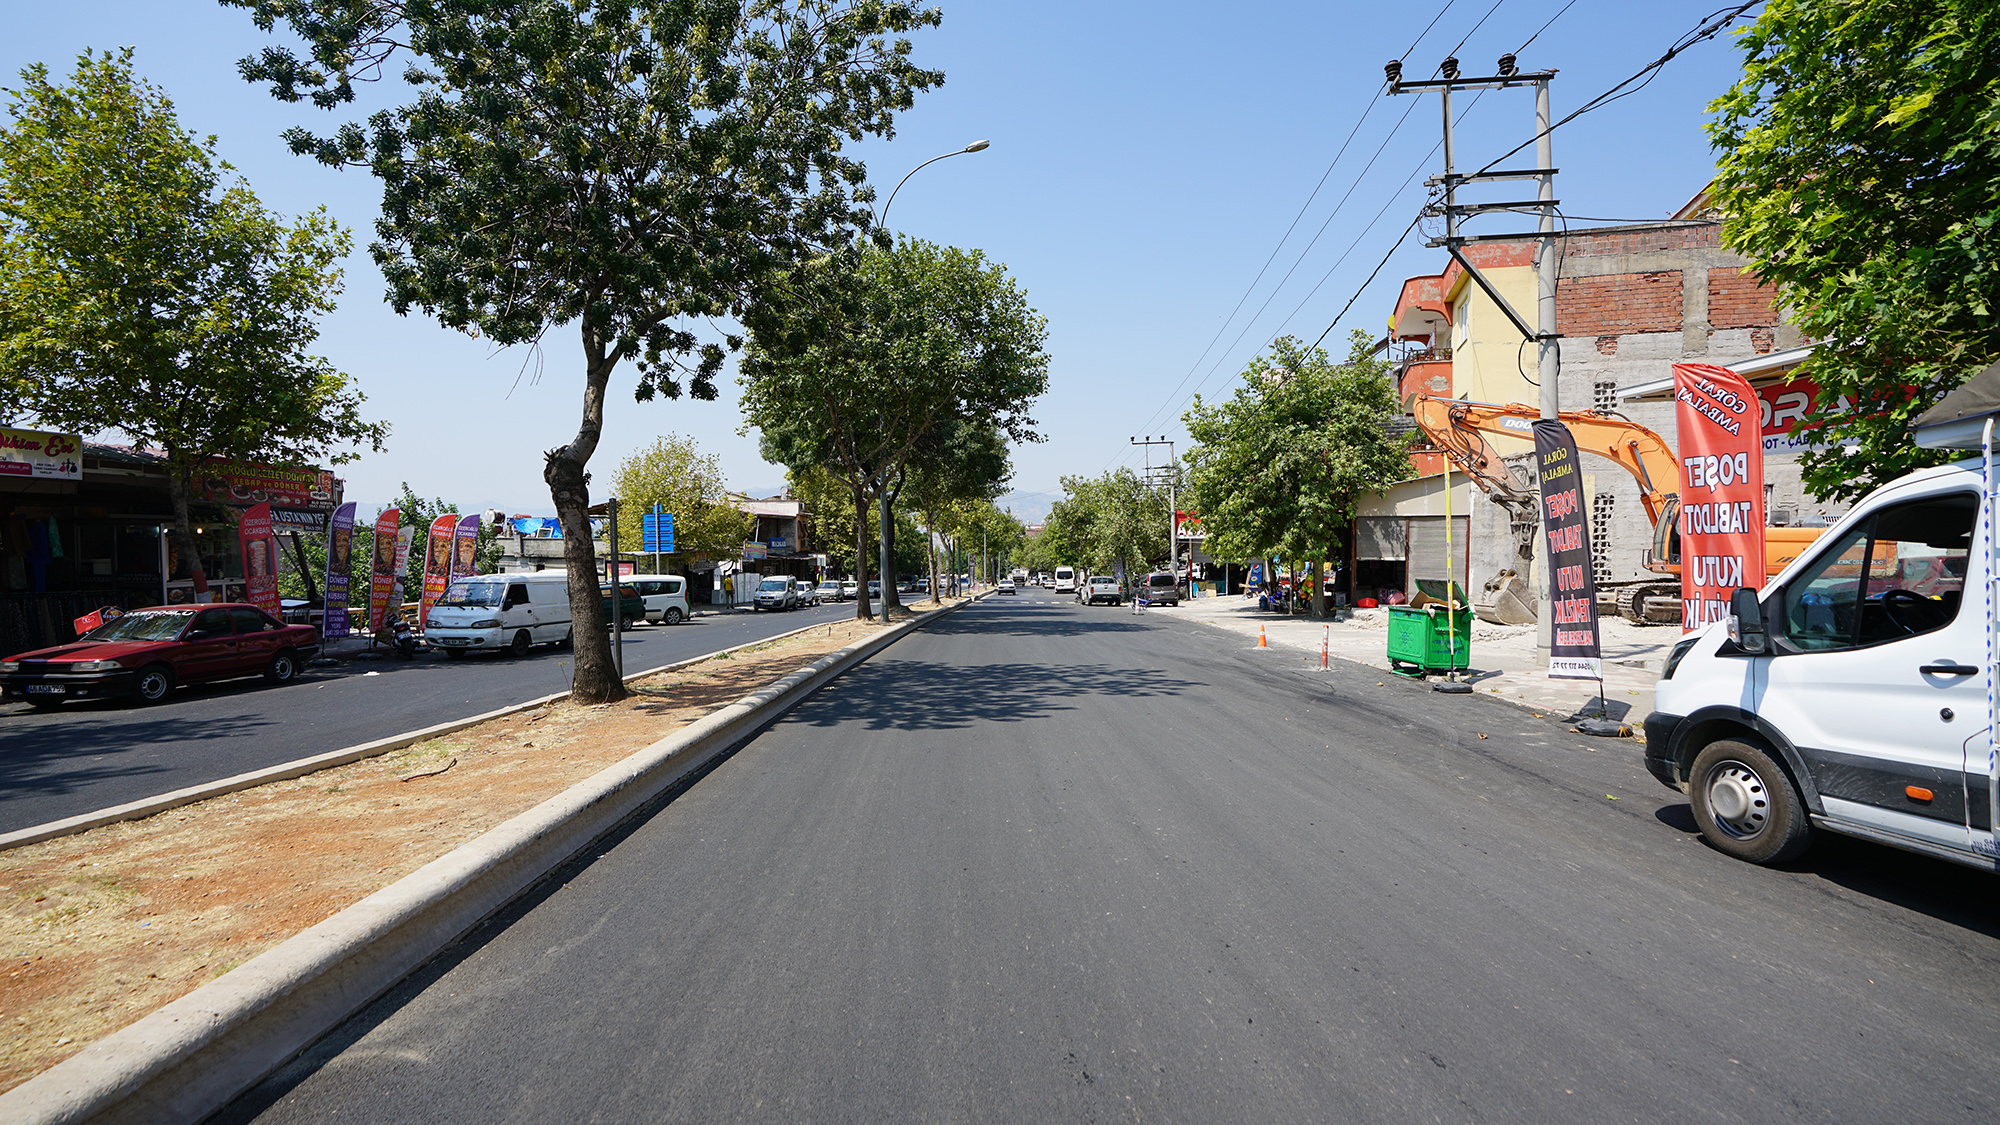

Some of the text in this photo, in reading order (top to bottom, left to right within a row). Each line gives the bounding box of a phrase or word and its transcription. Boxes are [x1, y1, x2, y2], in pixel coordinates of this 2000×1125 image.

[1504, 419, 1532, 430] DOO
[44, 435, 75, 457] Evi
[233, 477, 260, 486] KEBAP
[274, 481, 300, 490] DÖNER
[243, 517, 271, 526] ÖZEROĞLU
[244, 526, 270, 535] OCAKBAŞI
